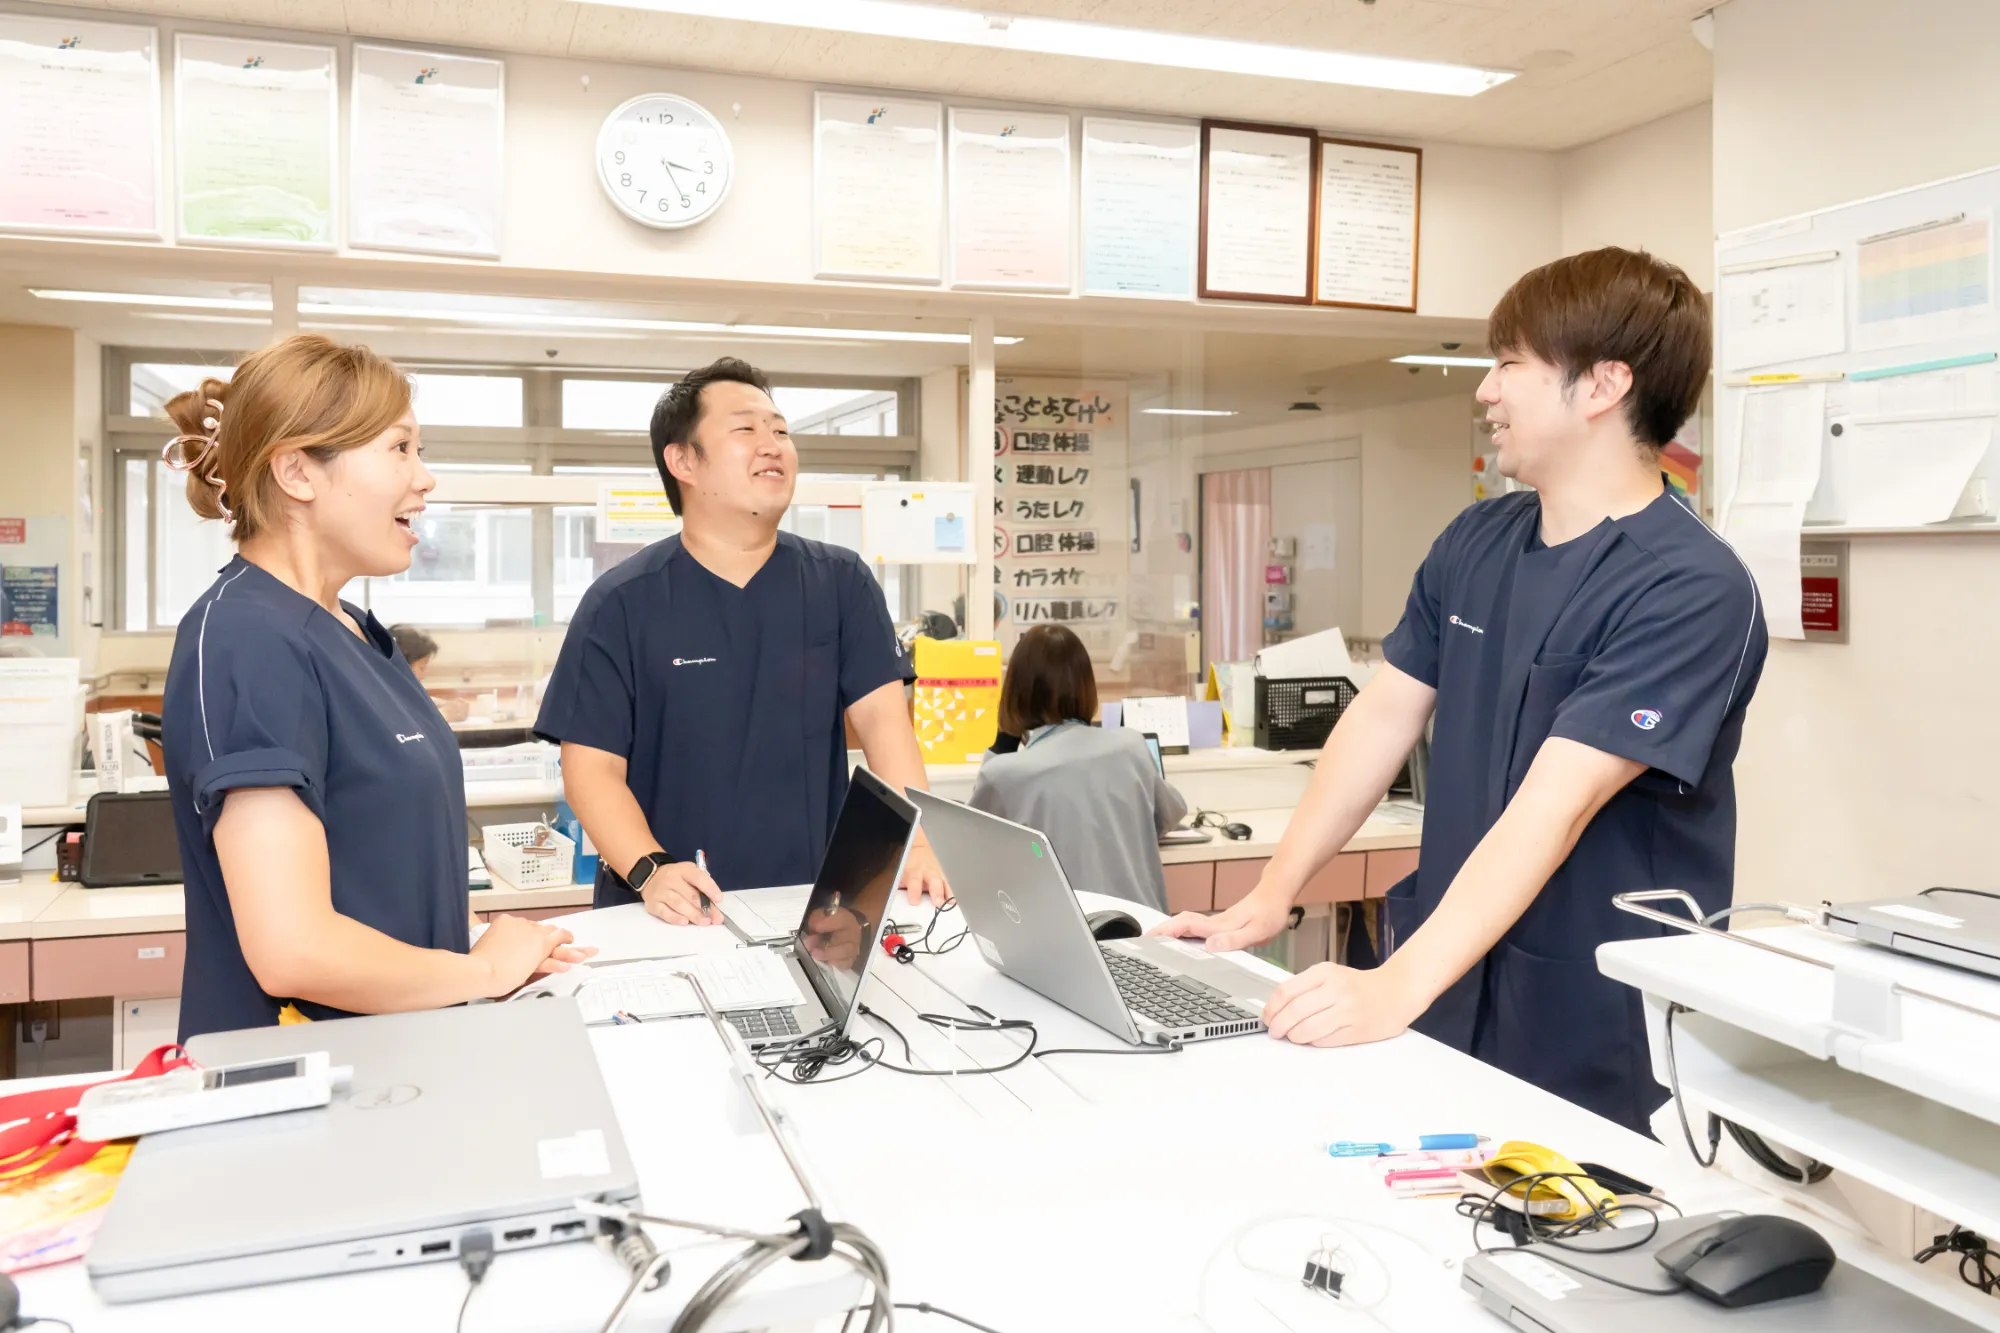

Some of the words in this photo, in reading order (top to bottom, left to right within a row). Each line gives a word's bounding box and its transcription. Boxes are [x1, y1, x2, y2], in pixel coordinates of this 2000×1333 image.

[614, 150, 626, 165] 9
[703, 161, 714, 175] 3
[620, 172, 632, 187] 8
[695, 181, 706, 195] 4
[637, 189, 648, 204] 7
[680, 194, 691, 209] 5
[658, 197, 669, 212] 6
[1016, 464, 1089, 485] 運動レク
[1016, 499, 1085, 519] うたレク
[1013, 567, 1085, 587] カラオケ
[672, 657, 717, 666] Champion
